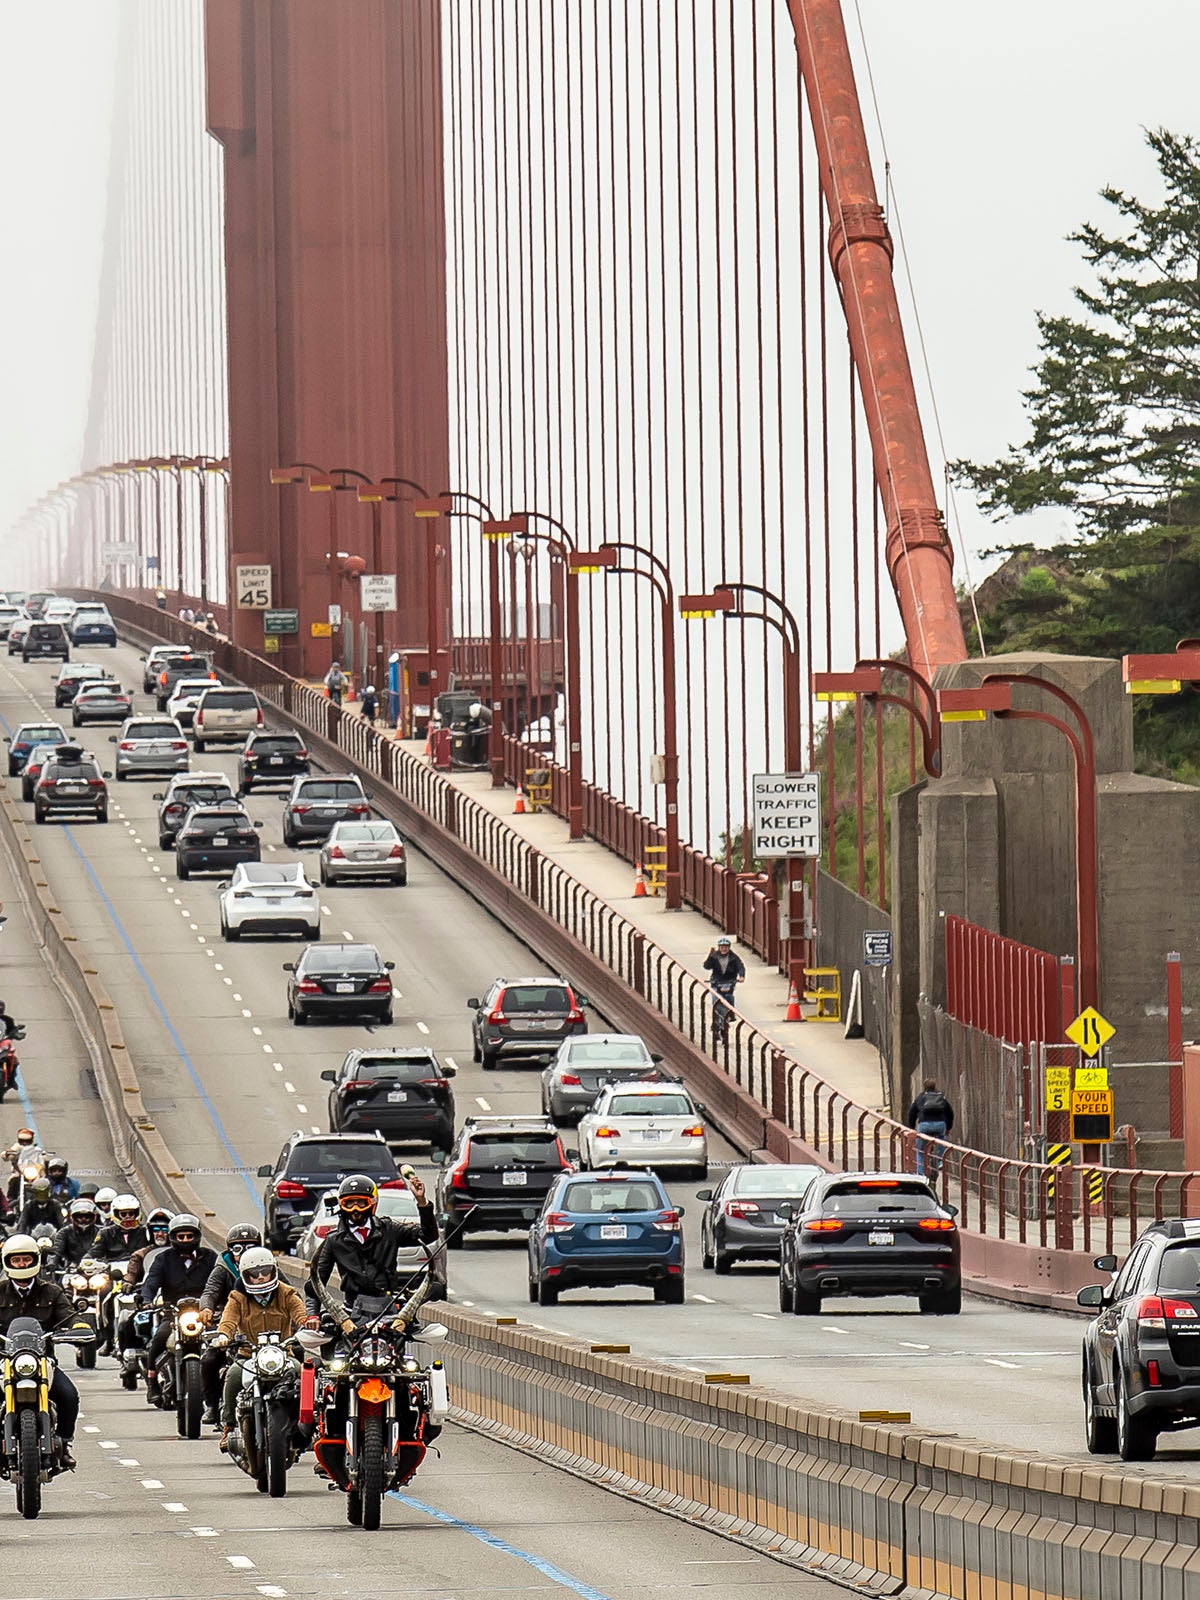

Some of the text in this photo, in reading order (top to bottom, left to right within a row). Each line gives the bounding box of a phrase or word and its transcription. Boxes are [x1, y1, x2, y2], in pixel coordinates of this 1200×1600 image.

[240, 568, 269, 576] SPEED
[243, 580, 265, 588] LIMIT
[240, 590, 269, 607] 45
[756, 783, 816, 794] SLOWER
[756, 800, 817, 810] TRAFFIC
[761, 816, 812, 829] KEEP
[757, 835, 816, 848] RIGHT
[1053, 1095, 1063, 1109] 5
[1077, 1093, 1106, 1102] YOUR
[1075, 1104, 1109, 1113] SPEED
